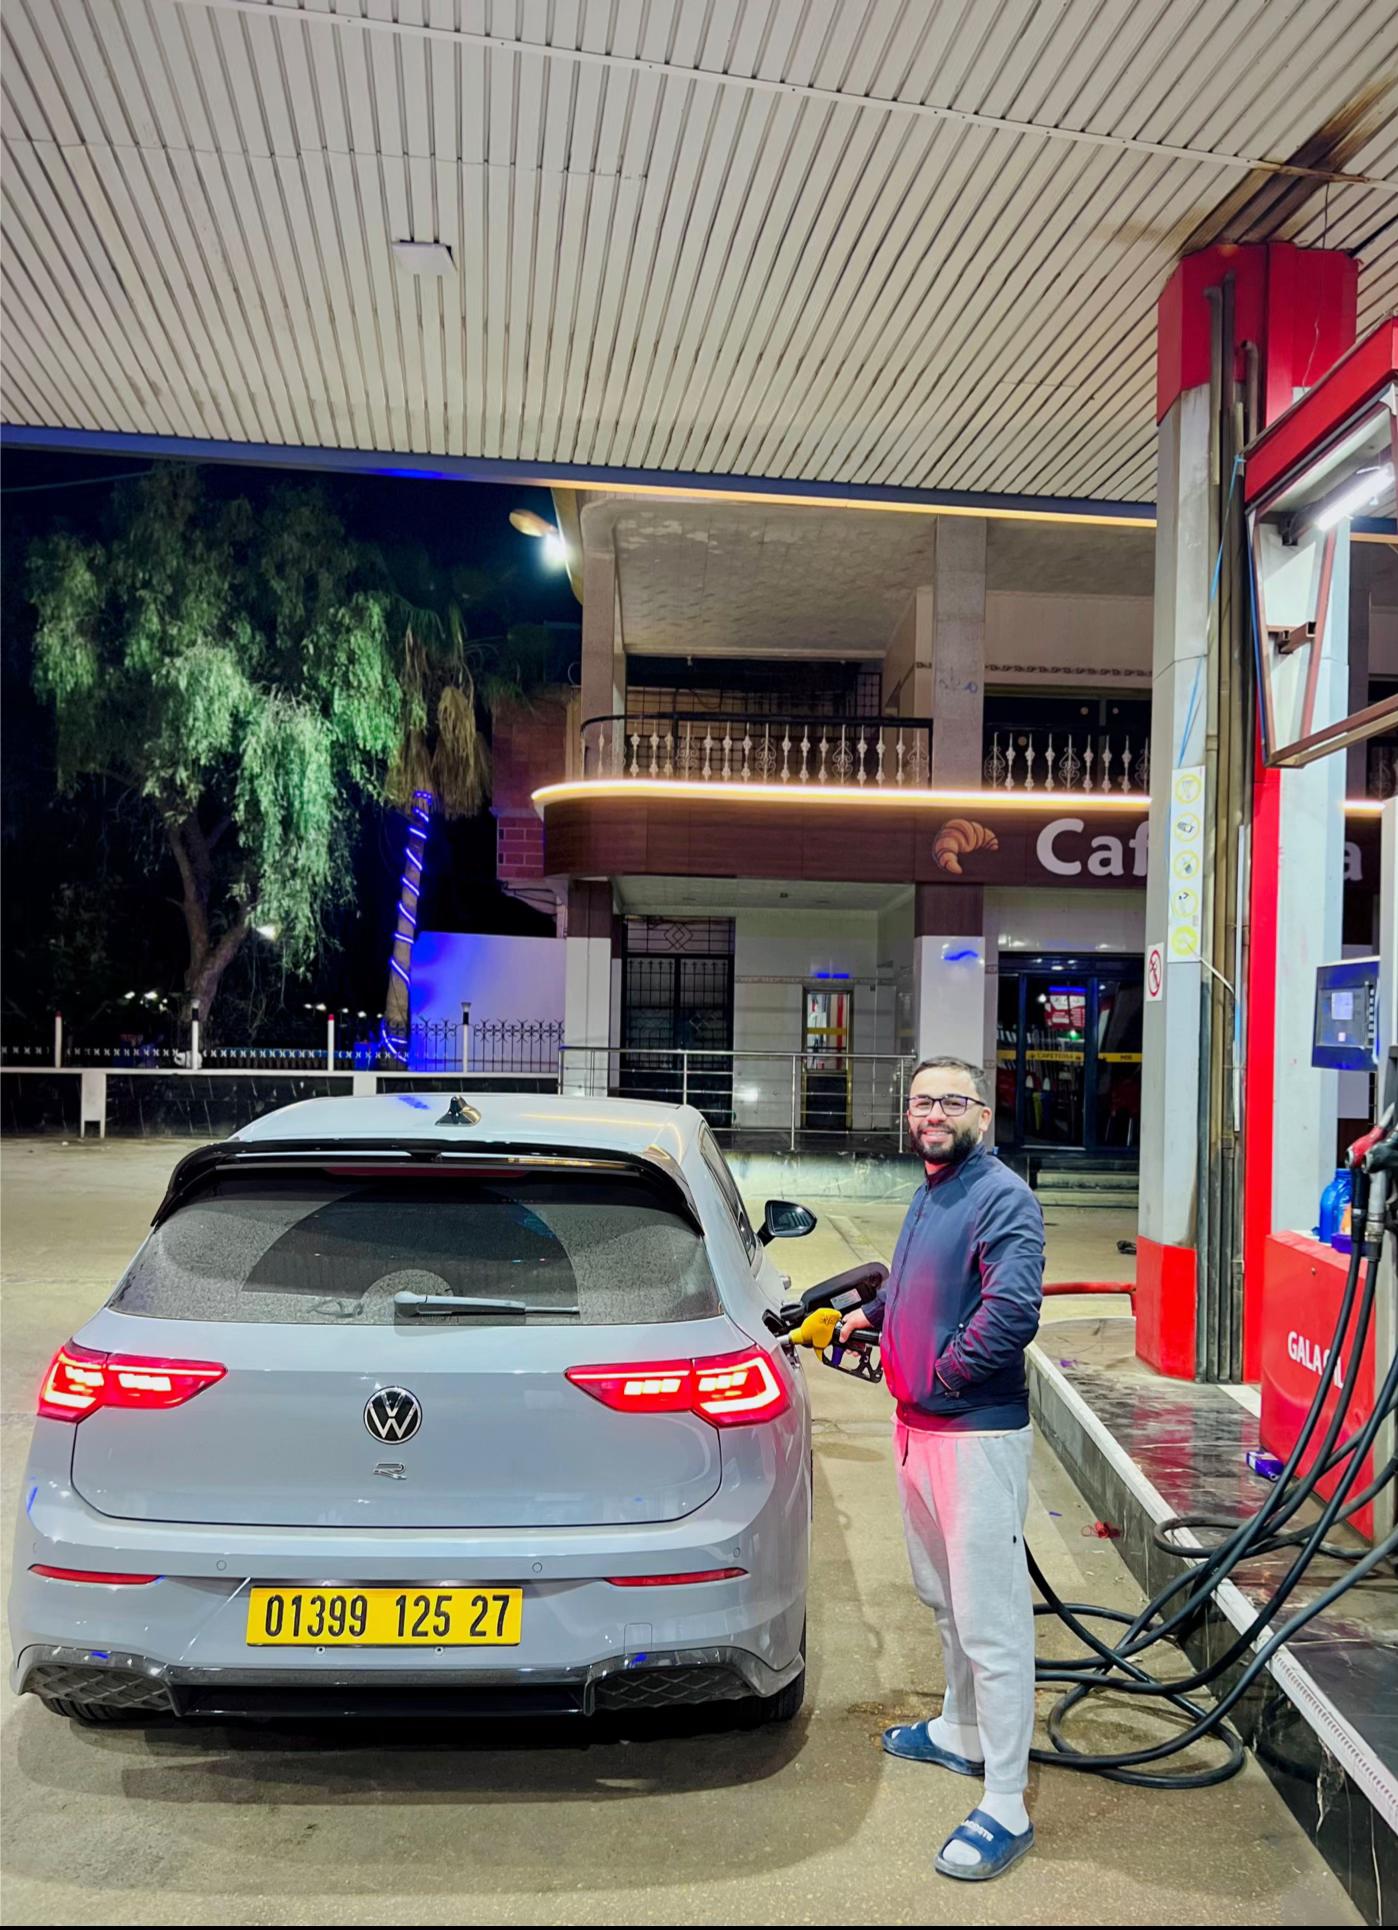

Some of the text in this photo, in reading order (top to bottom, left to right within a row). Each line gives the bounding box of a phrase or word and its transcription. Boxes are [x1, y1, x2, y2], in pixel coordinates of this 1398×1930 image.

[1037, 818, 1149, 876] Caf
[265, 1594, 510, 1637] 01399 125 27
